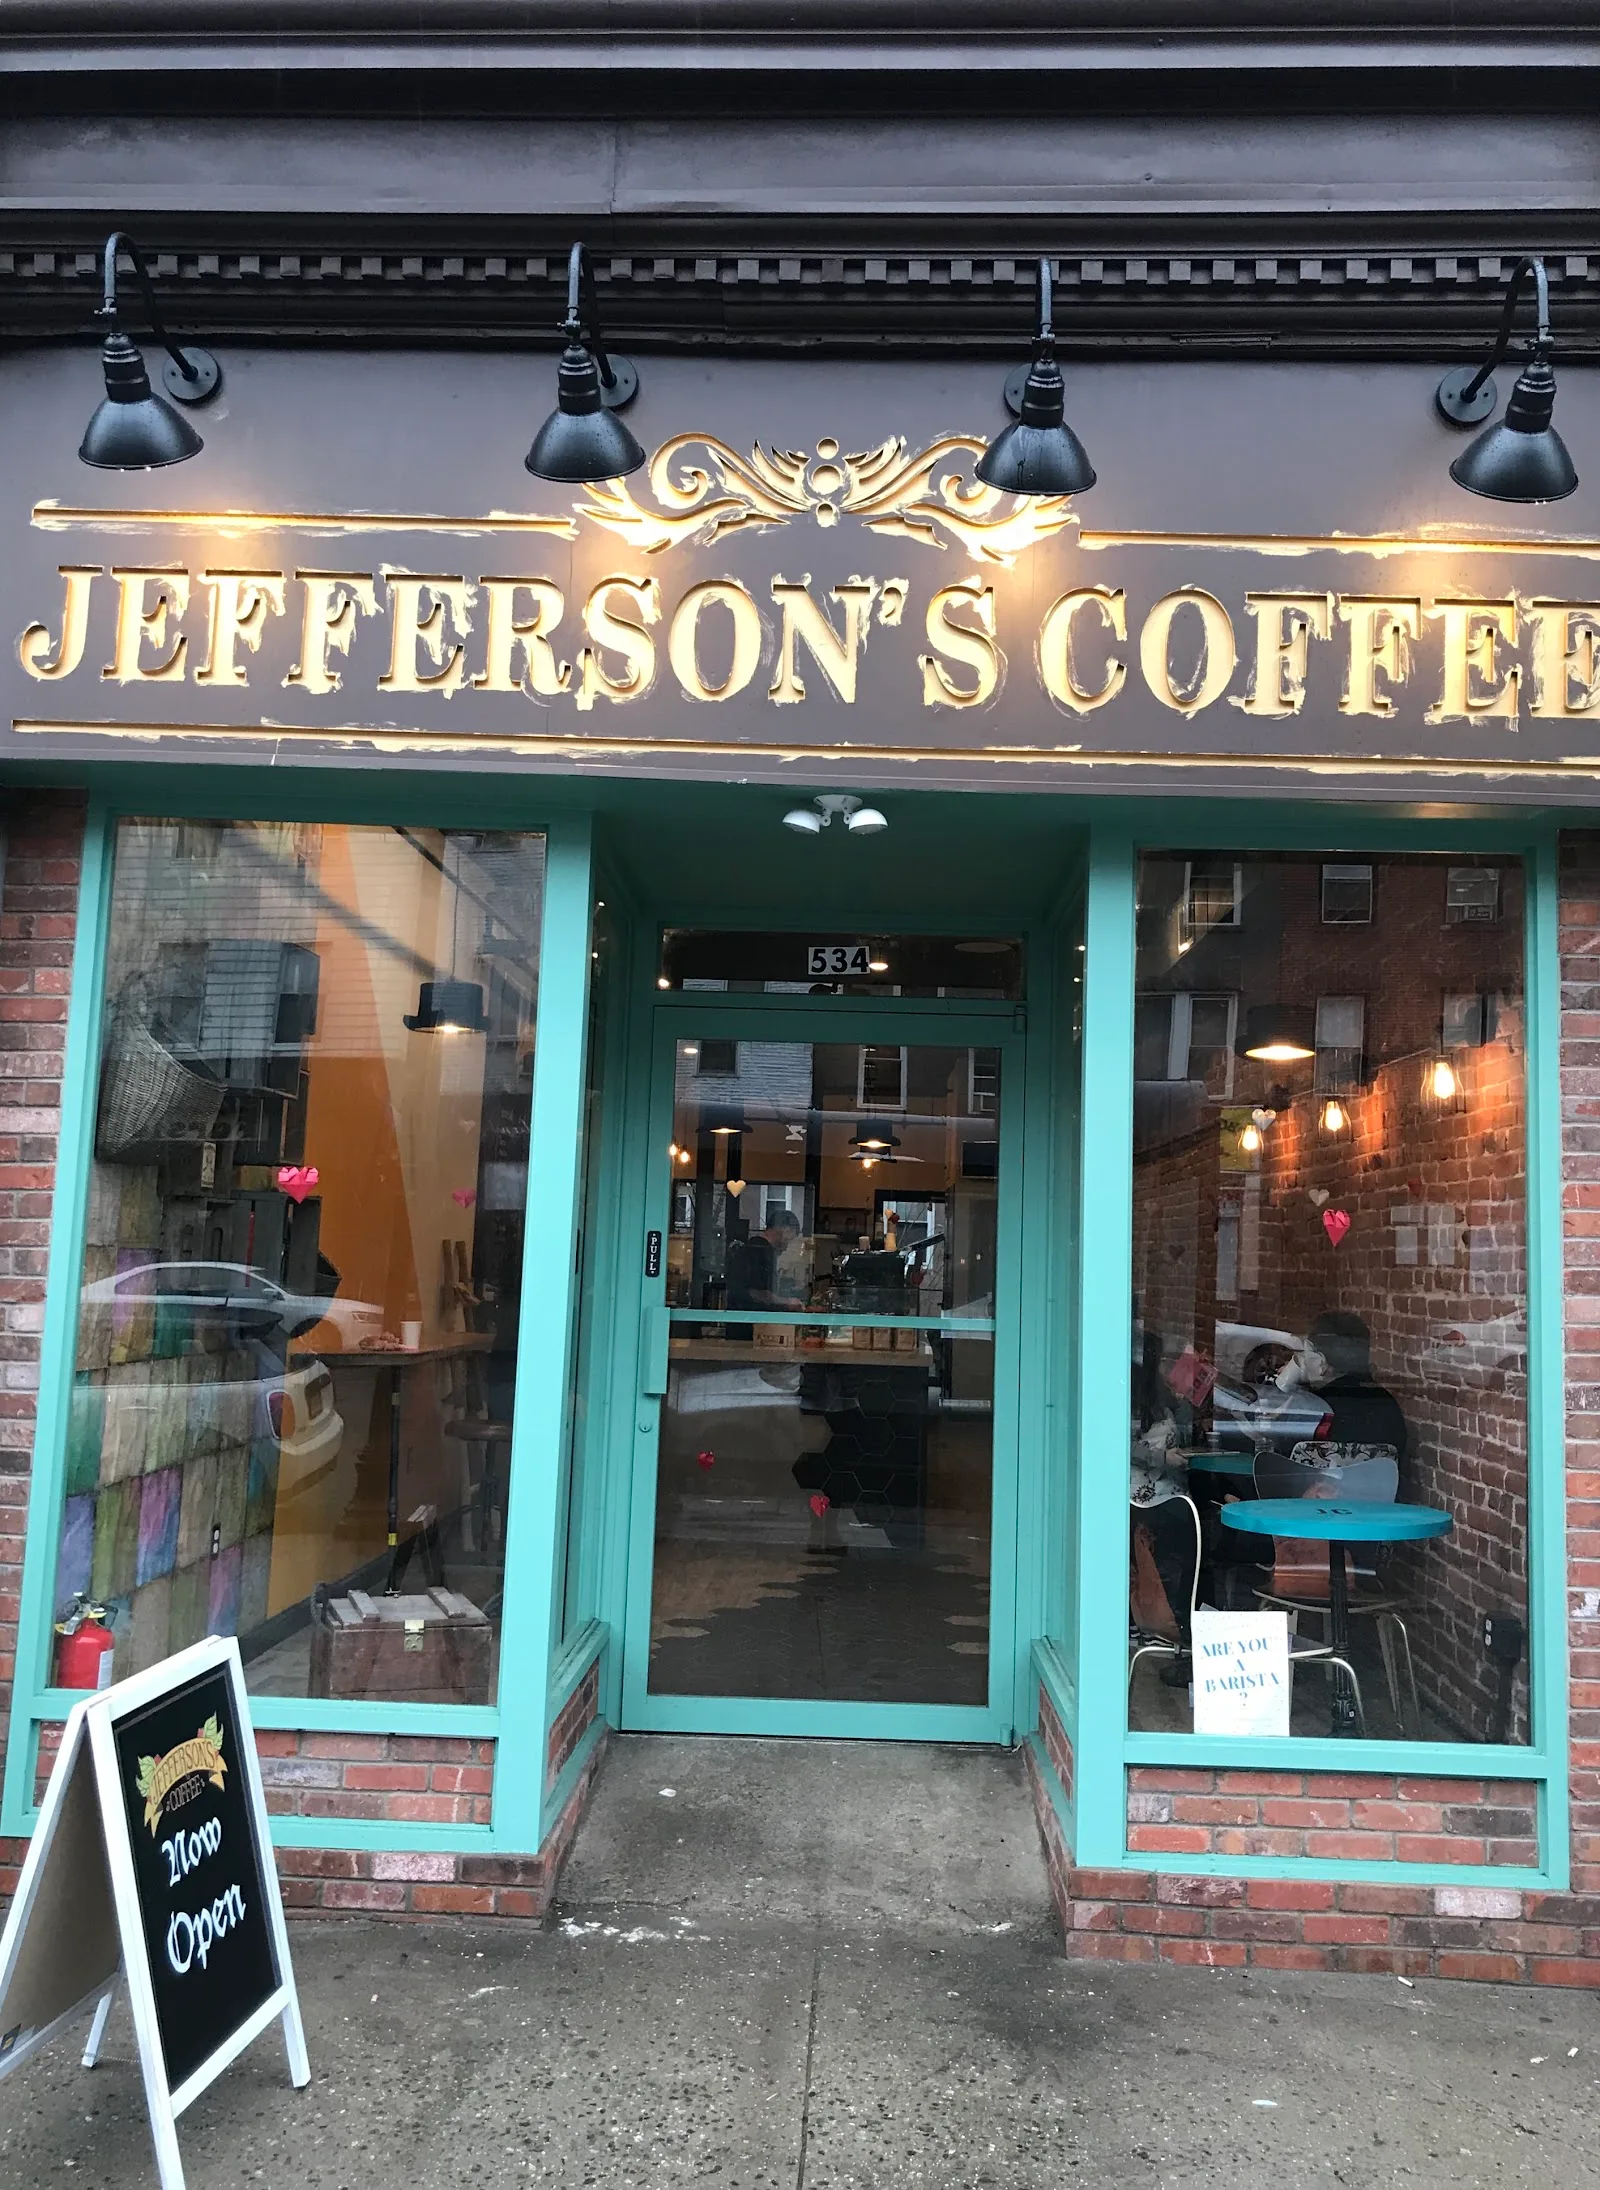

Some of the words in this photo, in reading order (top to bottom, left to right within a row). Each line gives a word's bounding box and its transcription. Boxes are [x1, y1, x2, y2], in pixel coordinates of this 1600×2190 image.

[20, 564, 1002, 708] JEFFERSON'S
[1038, 584, 1600, 722] COFFEE
[810, 947, 869, 974] 534
[649, 1236, 658, 1271] PULL
[1202, 1640, 1235, 1658] ARE
[1237, 1636, 1273, 1655] YOU
[1234, 1658, 1246, 1672] A
[1204, 1671, 1280, 1693] BARISTA
[1238, 1690, 1249, 1707] ?
[169, 1774, 203, 1812] COFFEE
[161, 1816, 222, 1888] Now
[167, 1883, 247, 1974] Open
